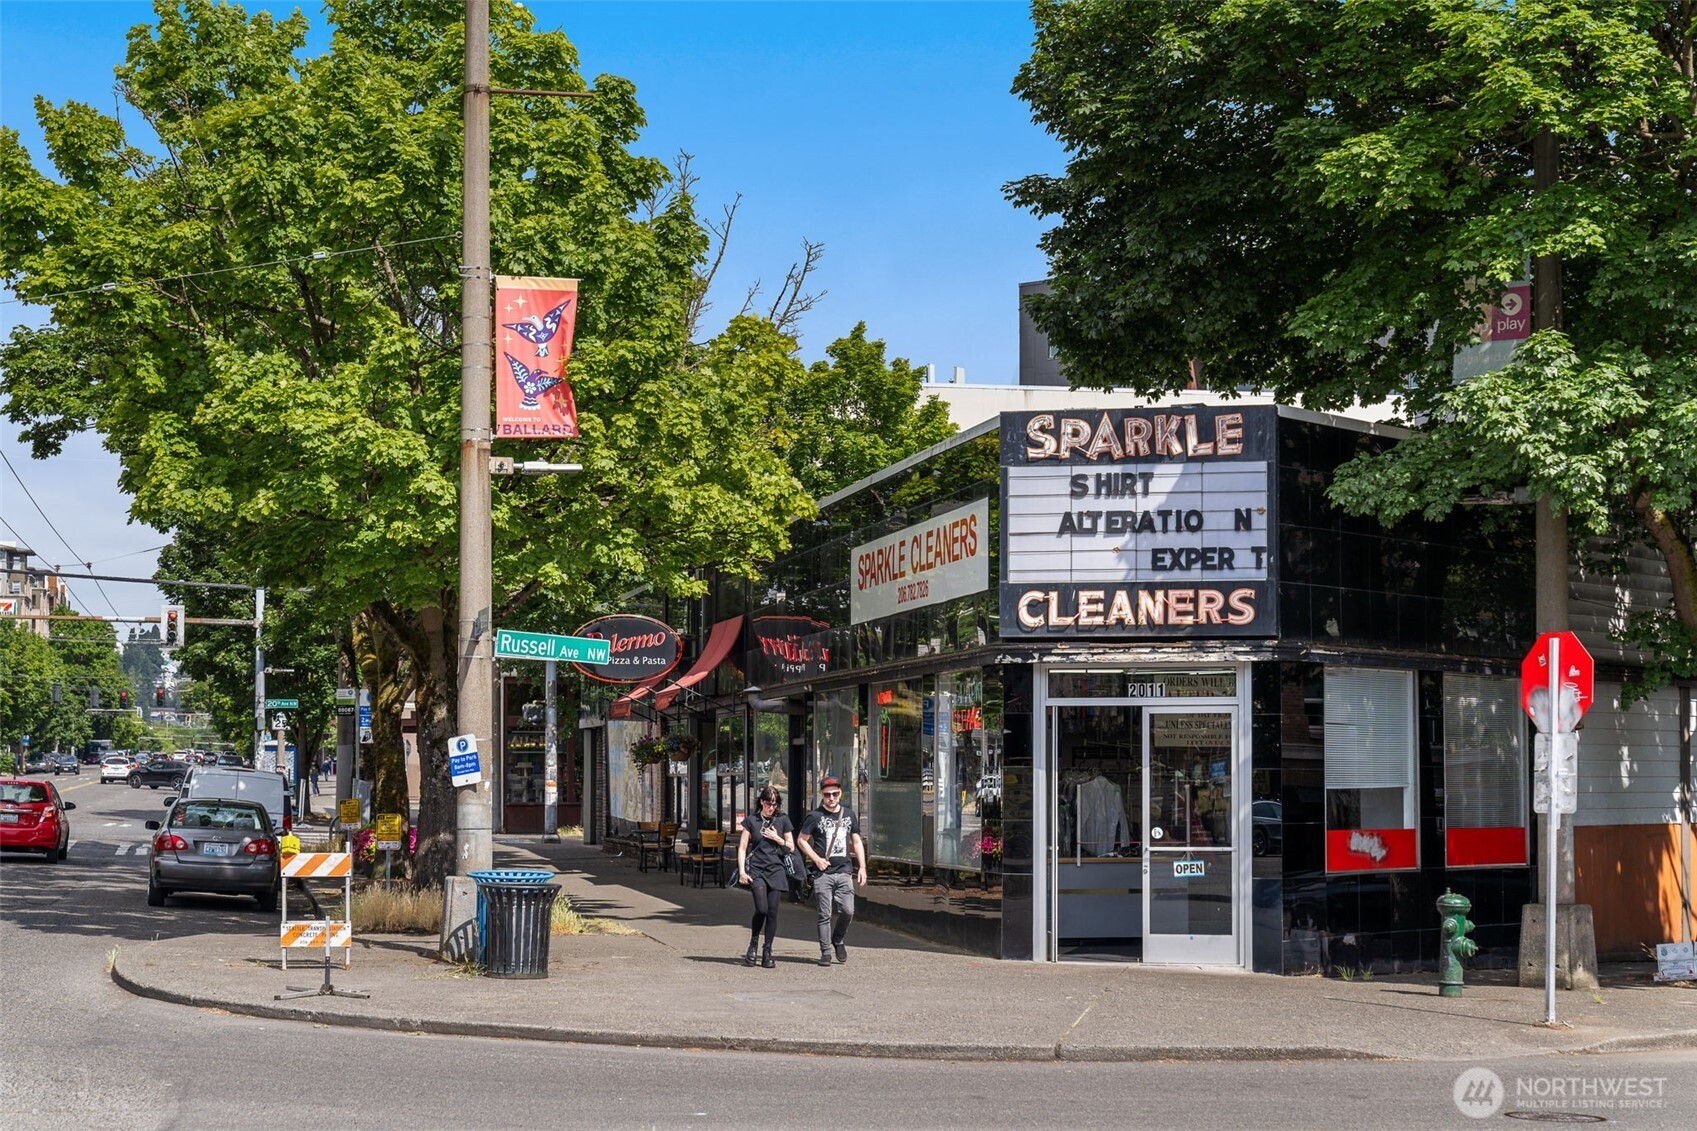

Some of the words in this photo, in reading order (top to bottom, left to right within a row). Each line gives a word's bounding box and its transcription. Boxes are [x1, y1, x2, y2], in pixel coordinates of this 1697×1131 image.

[1497, 317, 1526, 334] play
[502, 424, 574, 435] BALLARD
[1026, 411, 1244, 461] SPARKLE
[1069, 472, 1154, 498] SHIRT
[858, 540, 906, 591] SPARKLE
[910, 513, 978, 575] CLEANERS
[1017, 588, 1256, 627] CLEANERS
[501, 633, 556, 656] Russell
[559, 646, 579, 659] Ave
[587, 648, 607, 661] NW
[632, 656, 640, 665] &
[642, 656, 666, 665] Pasta
[1164, 676, 1199, 687] ORDERS
[1129, 684, 1164, 697] 2011
[275, 720, 287, 728] 25
[1175, 863, 1203, 875] OPEN
